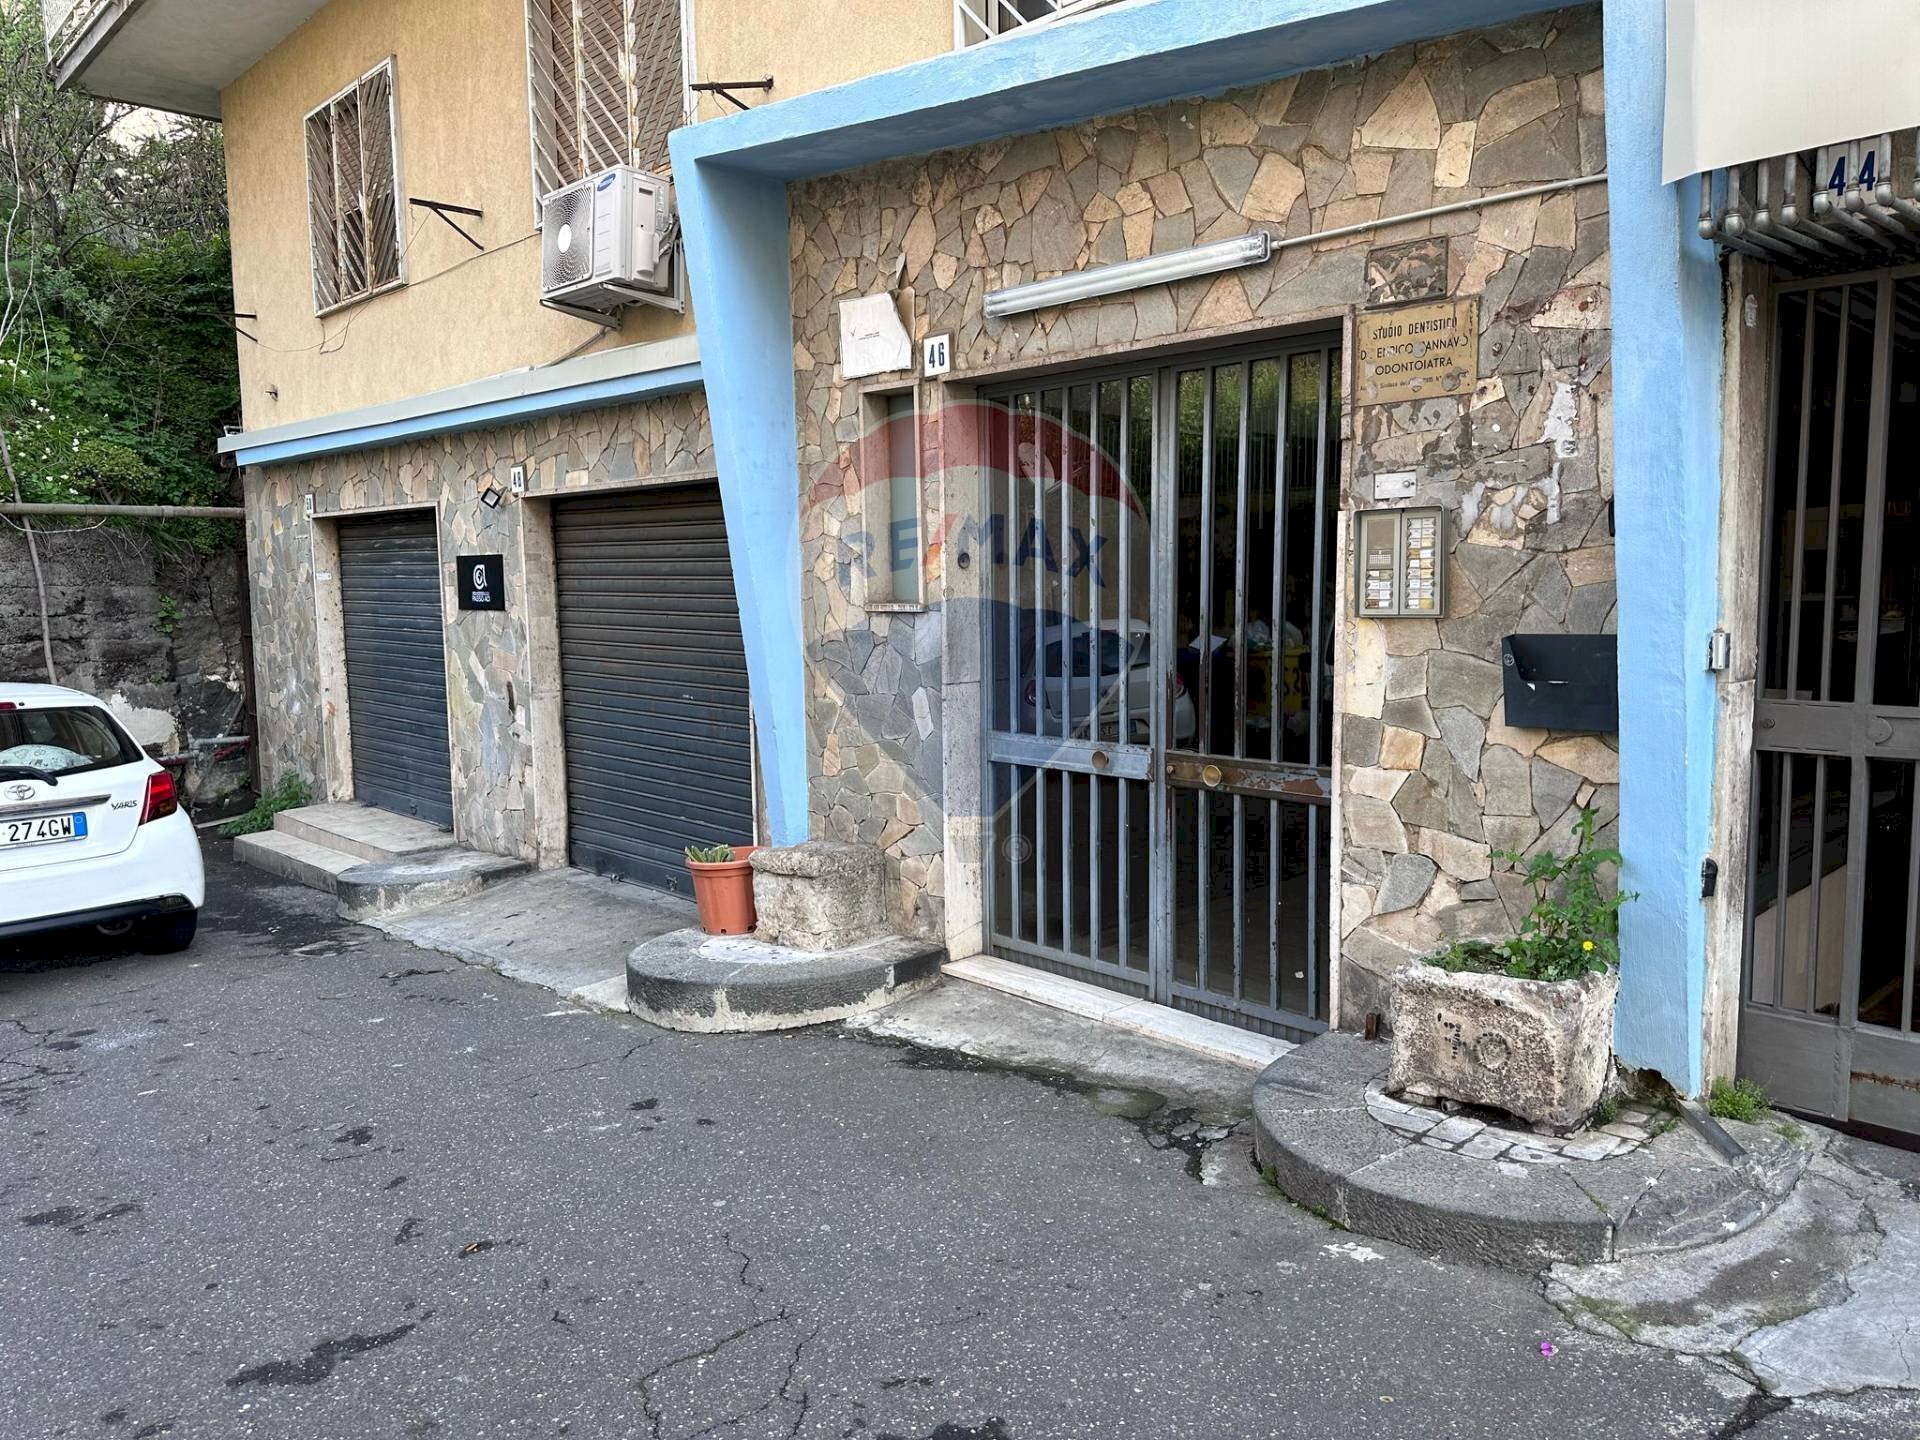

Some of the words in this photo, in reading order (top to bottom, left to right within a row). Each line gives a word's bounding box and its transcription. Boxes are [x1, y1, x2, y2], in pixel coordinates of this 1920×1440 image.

[1828, 150, 1876, 197] 44
[1372, 325, 1403, 340] STUDIO
[1408, 316, 1458, 335] DENTISTICO
[928, 342, 945, 368] 46
[1375, 356, 1453, 376] ODONTOIATRA
[111, 799, 138, 812] YARIS
[8, 818, 73, 843] 274GW
